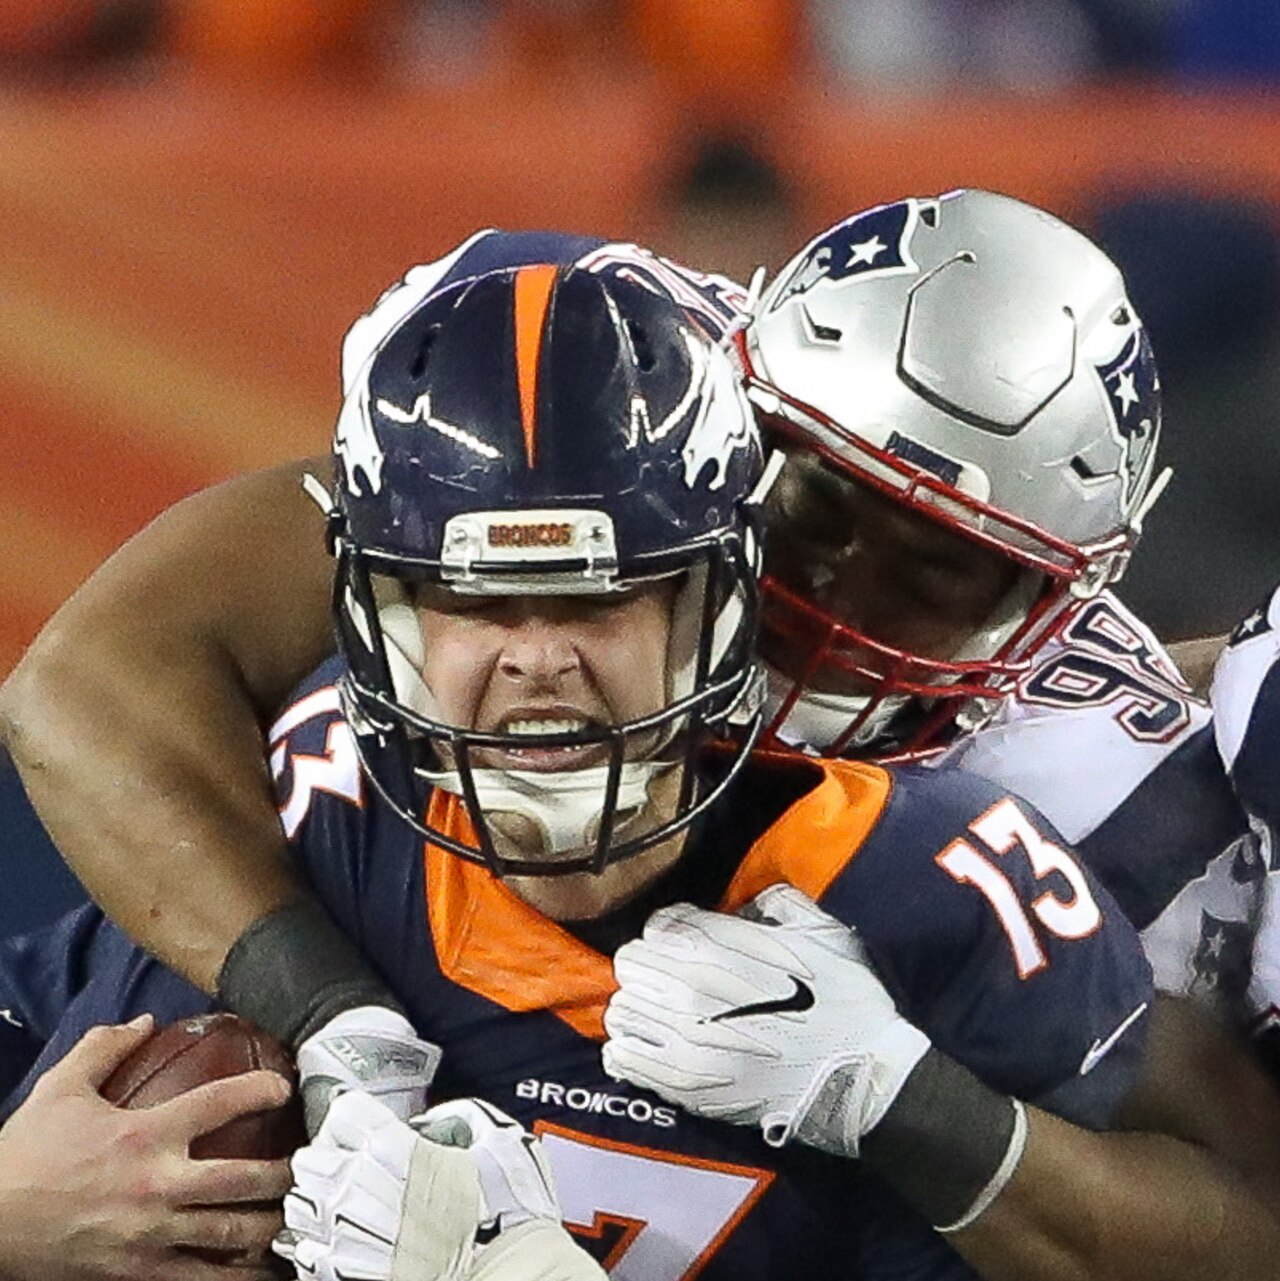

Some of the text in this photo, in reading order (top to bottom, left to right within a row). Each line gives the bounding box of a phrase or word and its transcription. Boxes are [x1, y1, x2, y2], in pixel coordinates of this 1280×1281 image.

[487, 522, 577, 548] BRONCOS
[934, 796, 1104, 980] 13
[516, 1078, 677, 1128] BRONCOS
